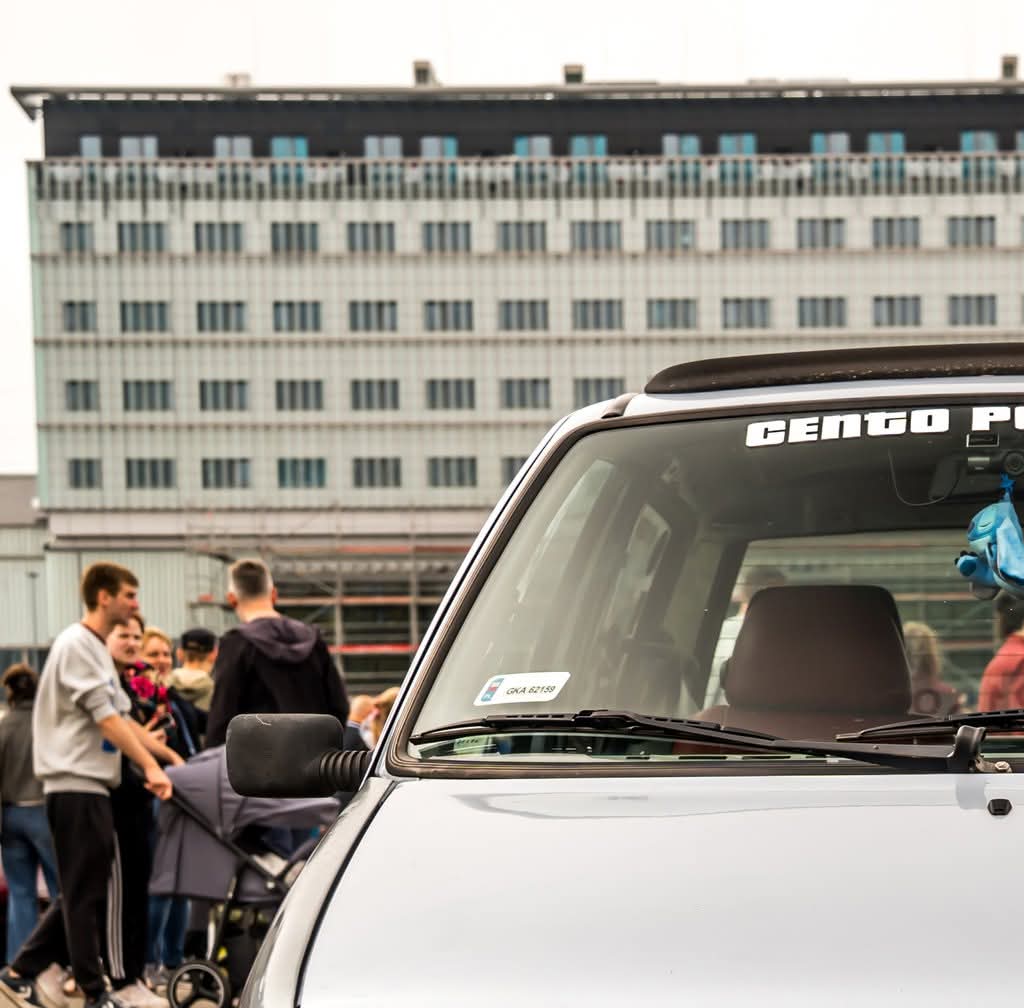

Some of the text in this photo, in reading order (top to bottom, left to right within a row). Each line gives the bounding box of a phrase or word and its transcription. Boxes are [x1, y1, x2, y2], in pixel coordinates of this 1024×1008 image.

[745, 408, 950, 448] CENTO
[505, 684, 557, 696] GKA 62159
